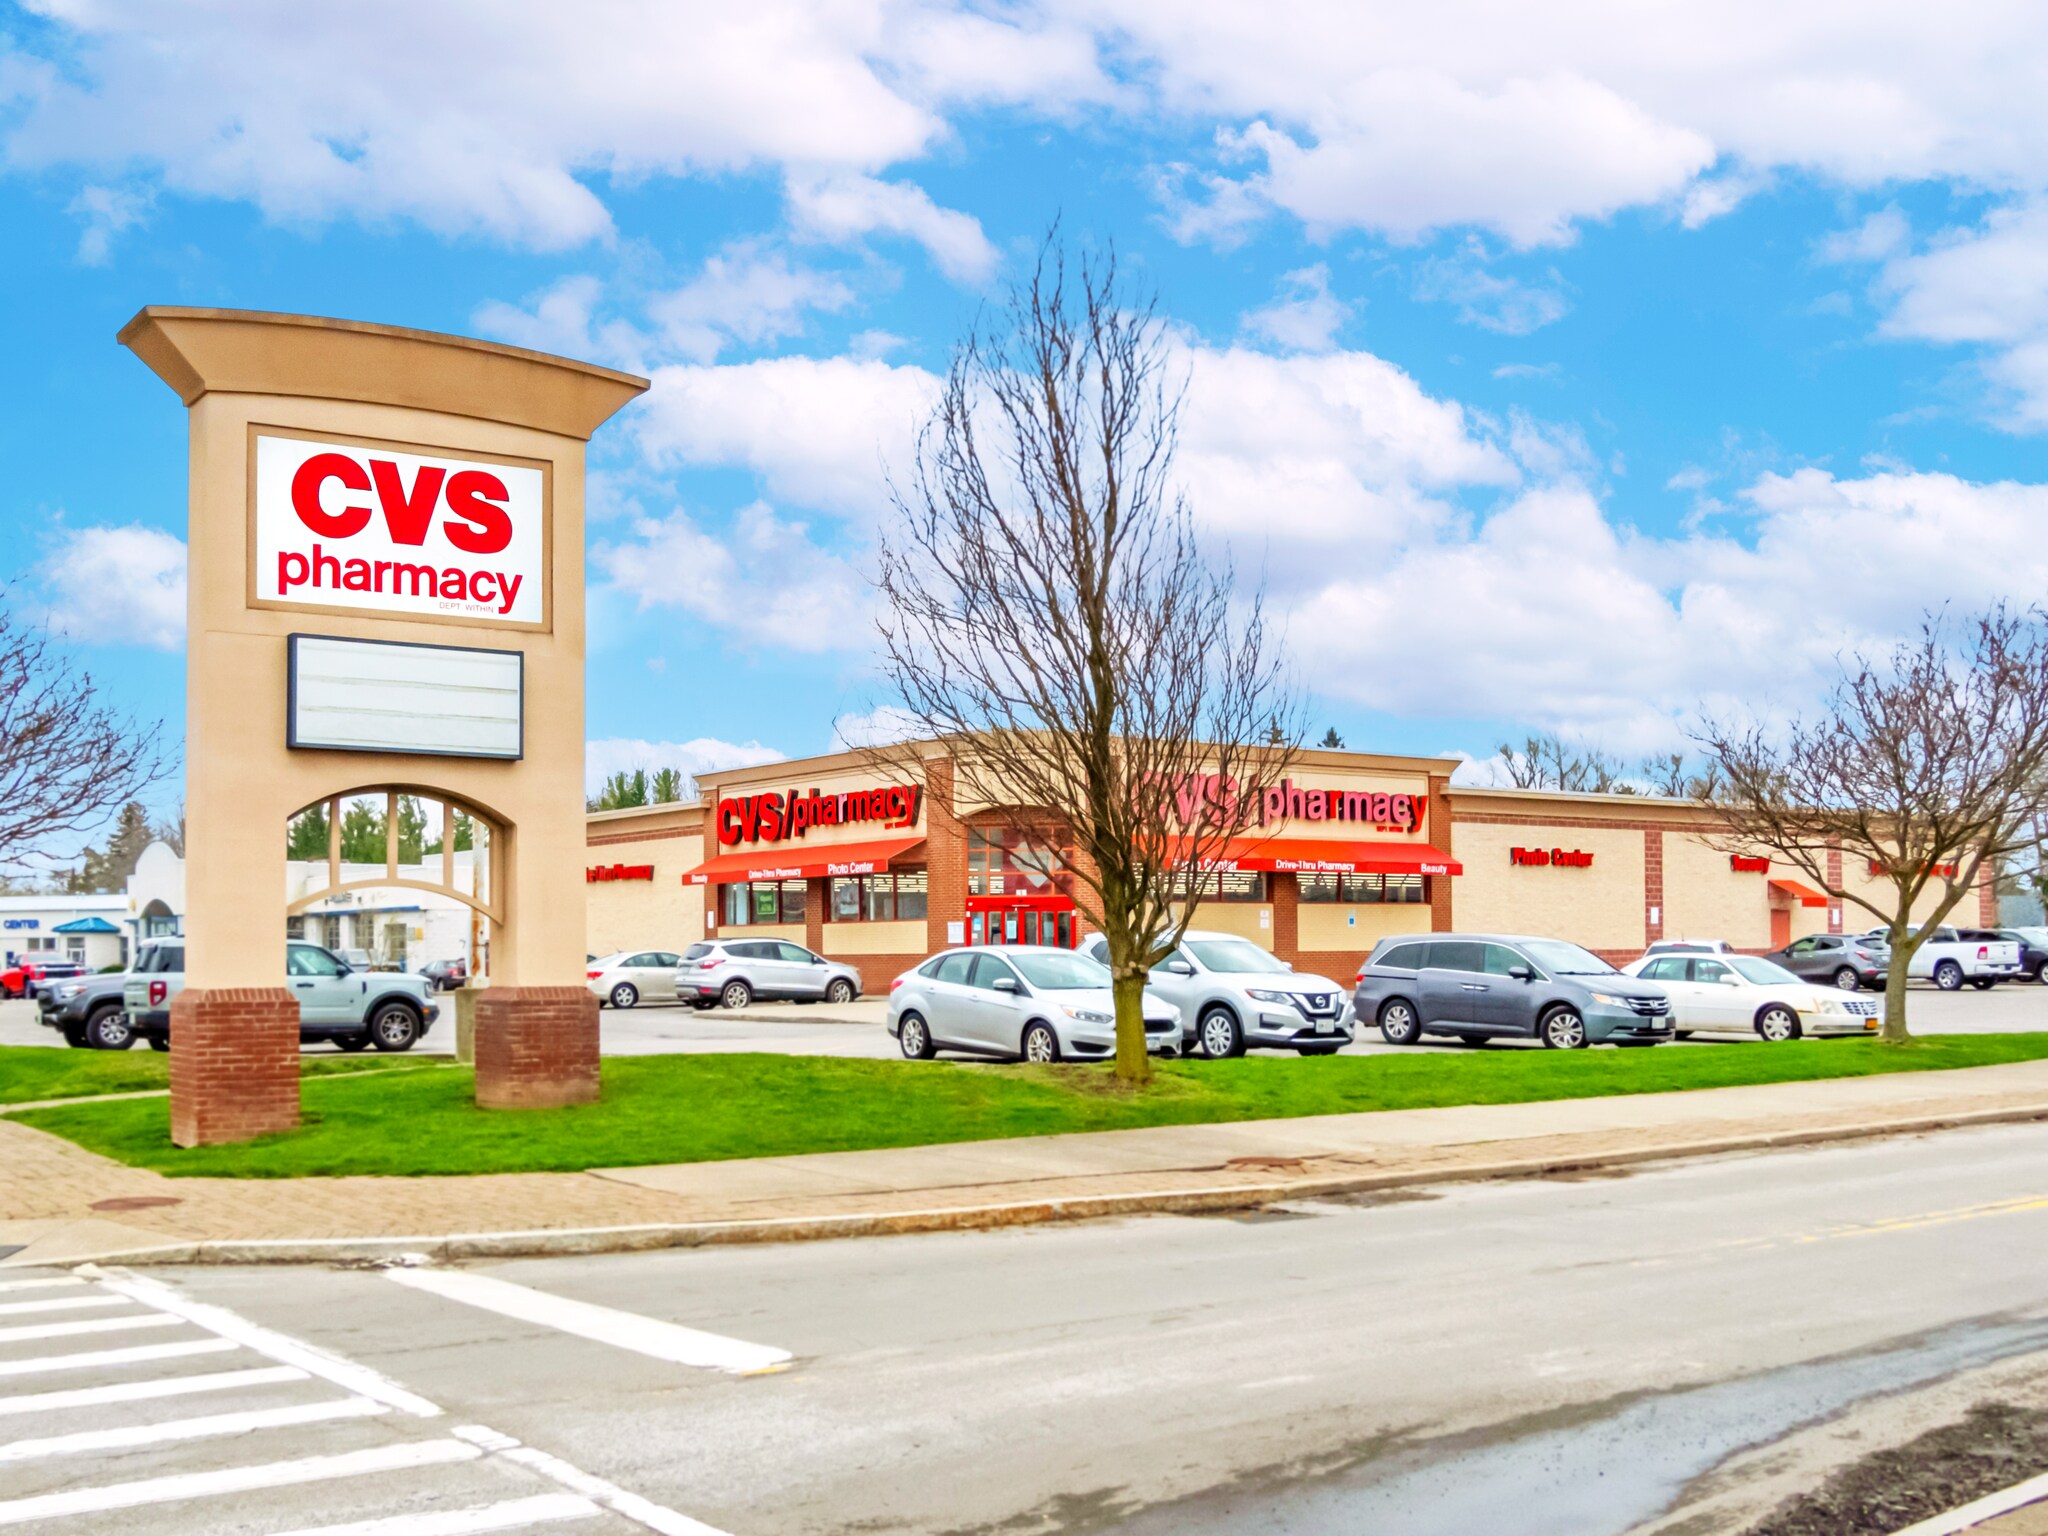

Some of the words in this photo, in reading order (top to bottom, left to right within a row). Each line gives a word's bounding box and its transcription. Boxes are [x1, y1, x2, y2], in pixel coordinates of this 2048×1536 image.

[291, 453, 512, 554] CVS
[278, 544, 523, 614] pharmacy
[439, 602, 461, 610] DEPT
[465, 604, 494, 613] WITHIN
[827, 864, 849, 875] Photo
[850, 862, 875, 873] Center
[1275, 860, 1316, 870] Drive-Thru
[1317, 861, 1355, 872] Pharmacy
[1420, 863, 1447, 874] Beauty
